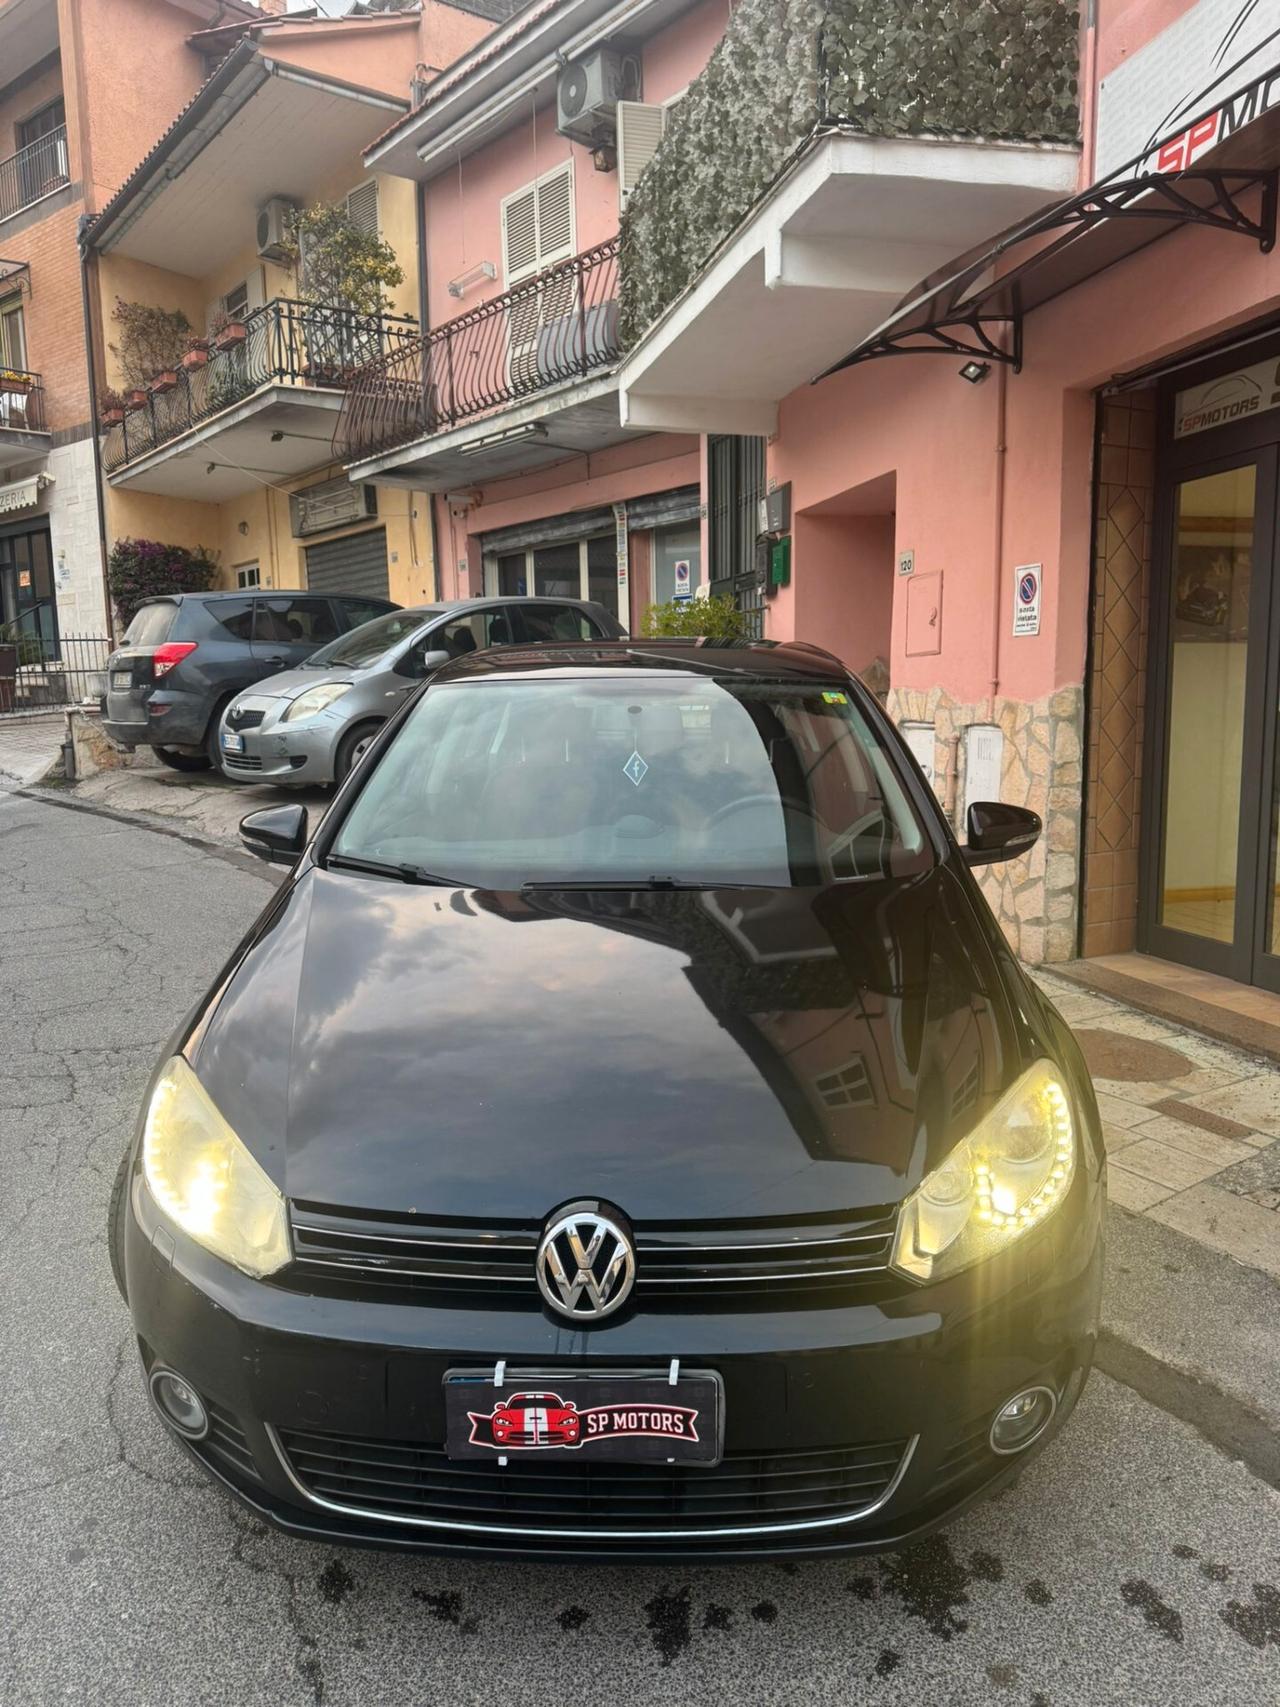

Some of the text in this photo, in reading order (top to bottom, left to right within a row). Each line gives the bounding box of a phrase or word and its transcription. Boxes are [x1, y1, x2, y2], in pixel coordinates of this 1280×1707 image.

[1183, 396, 1259, 432] SPMOTORS
[900, 559, 912, 571] 120
[587, 1412, 684, 1434] SP MOTORS
